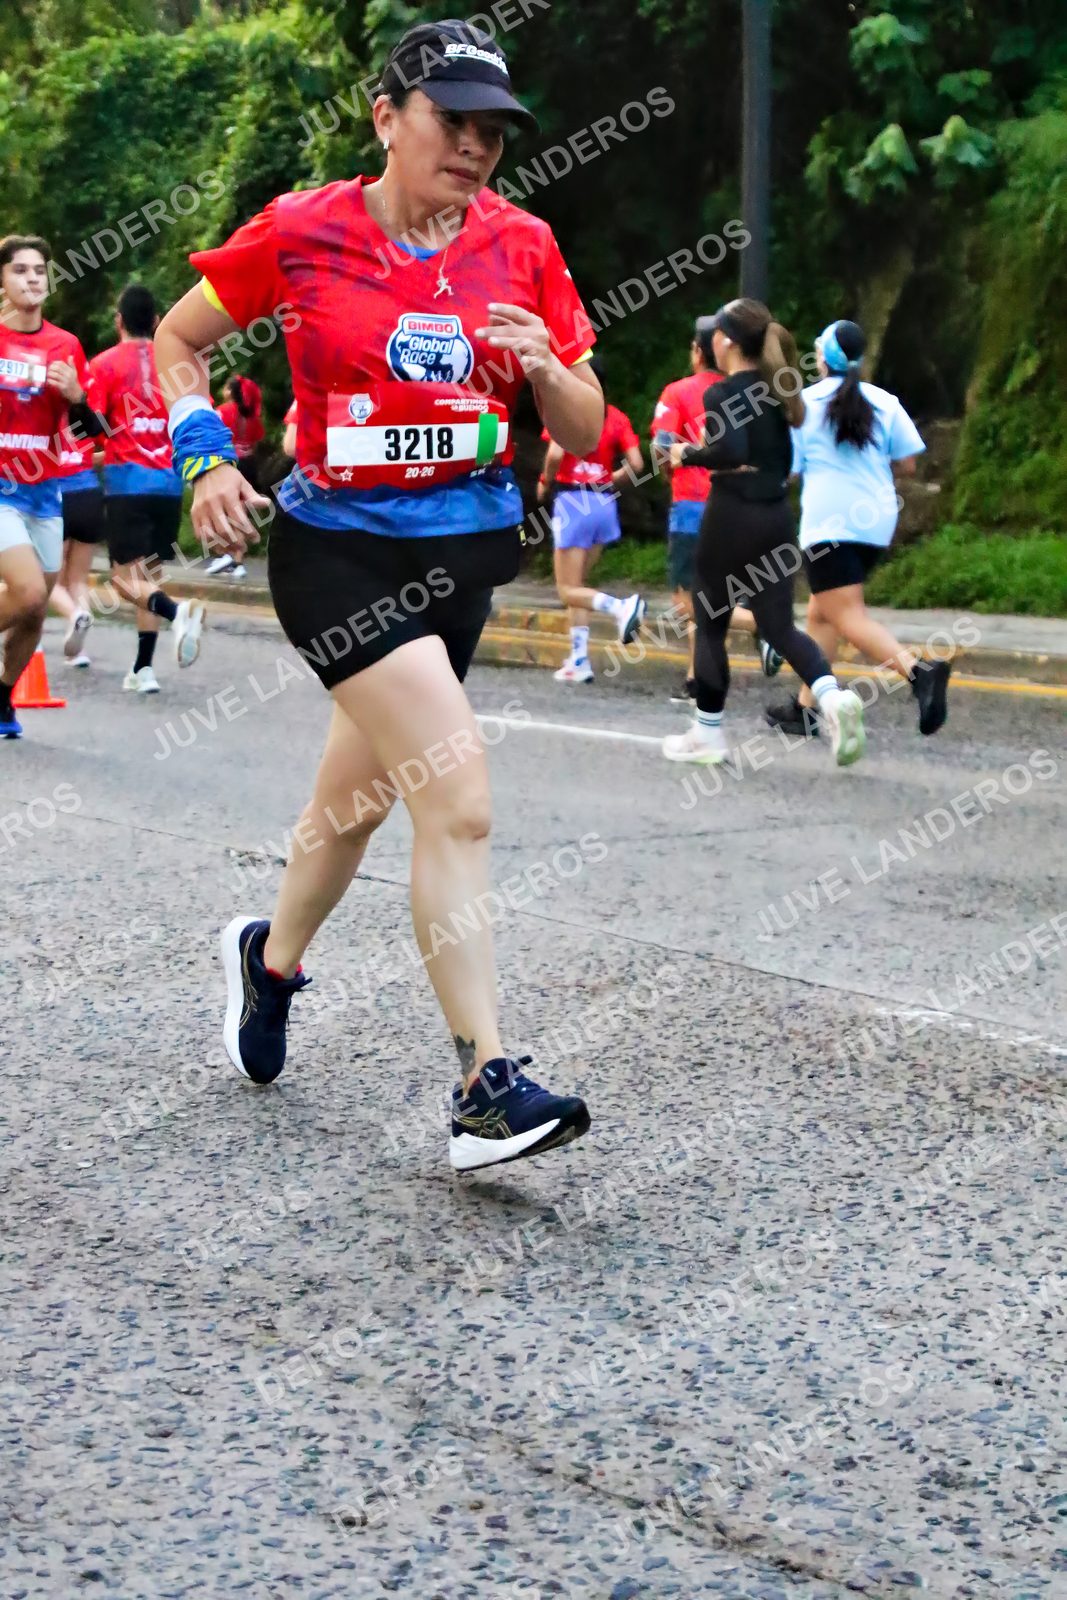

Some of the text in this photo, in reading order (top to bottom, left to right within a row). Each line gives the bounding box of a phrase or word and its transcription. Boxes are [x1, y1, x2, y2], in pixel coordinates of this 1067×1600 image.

[408, 321, 453, 333] BIMBO
[409, 337, 454, 353] Global
[401, 349, 436, 365] Race
[384, 427, 453, 461] 3218
